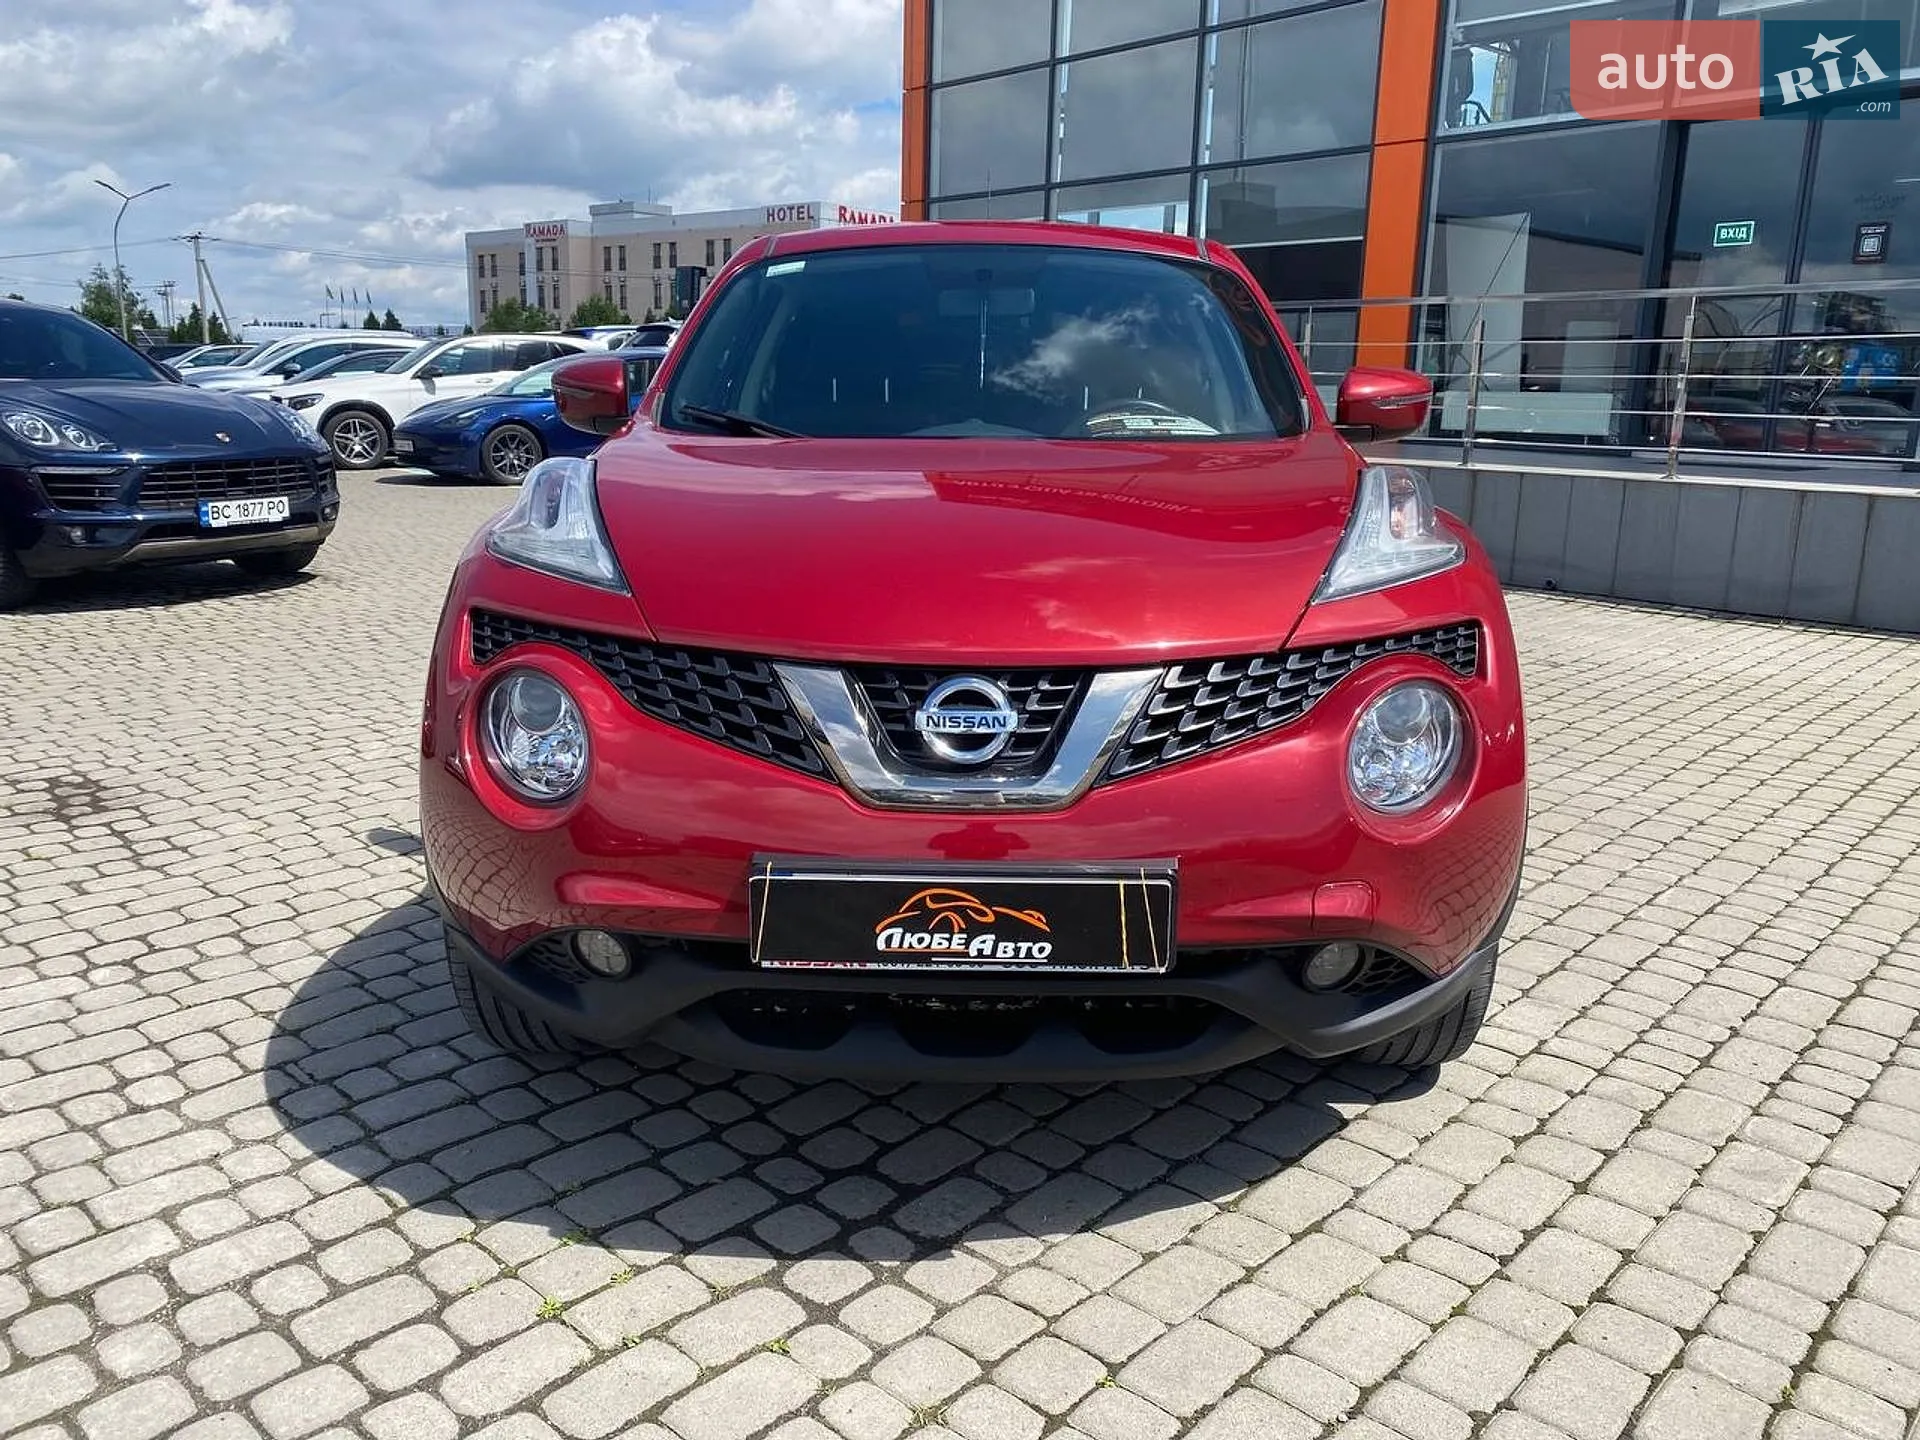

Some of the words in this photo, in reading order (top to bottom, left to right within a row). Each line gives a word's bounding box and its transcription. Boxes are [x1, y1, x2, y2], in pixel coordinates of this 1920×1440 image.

[766, 204, 815, 223] HOTEL
[1720, 227, 1748, 239] ВХІД
[211, 505, 231, 520] BC
[235, 502, 264, 518] 1877
[267, 500, 285, 515] PO
[926, 715, 1007, 729] NISSAN
